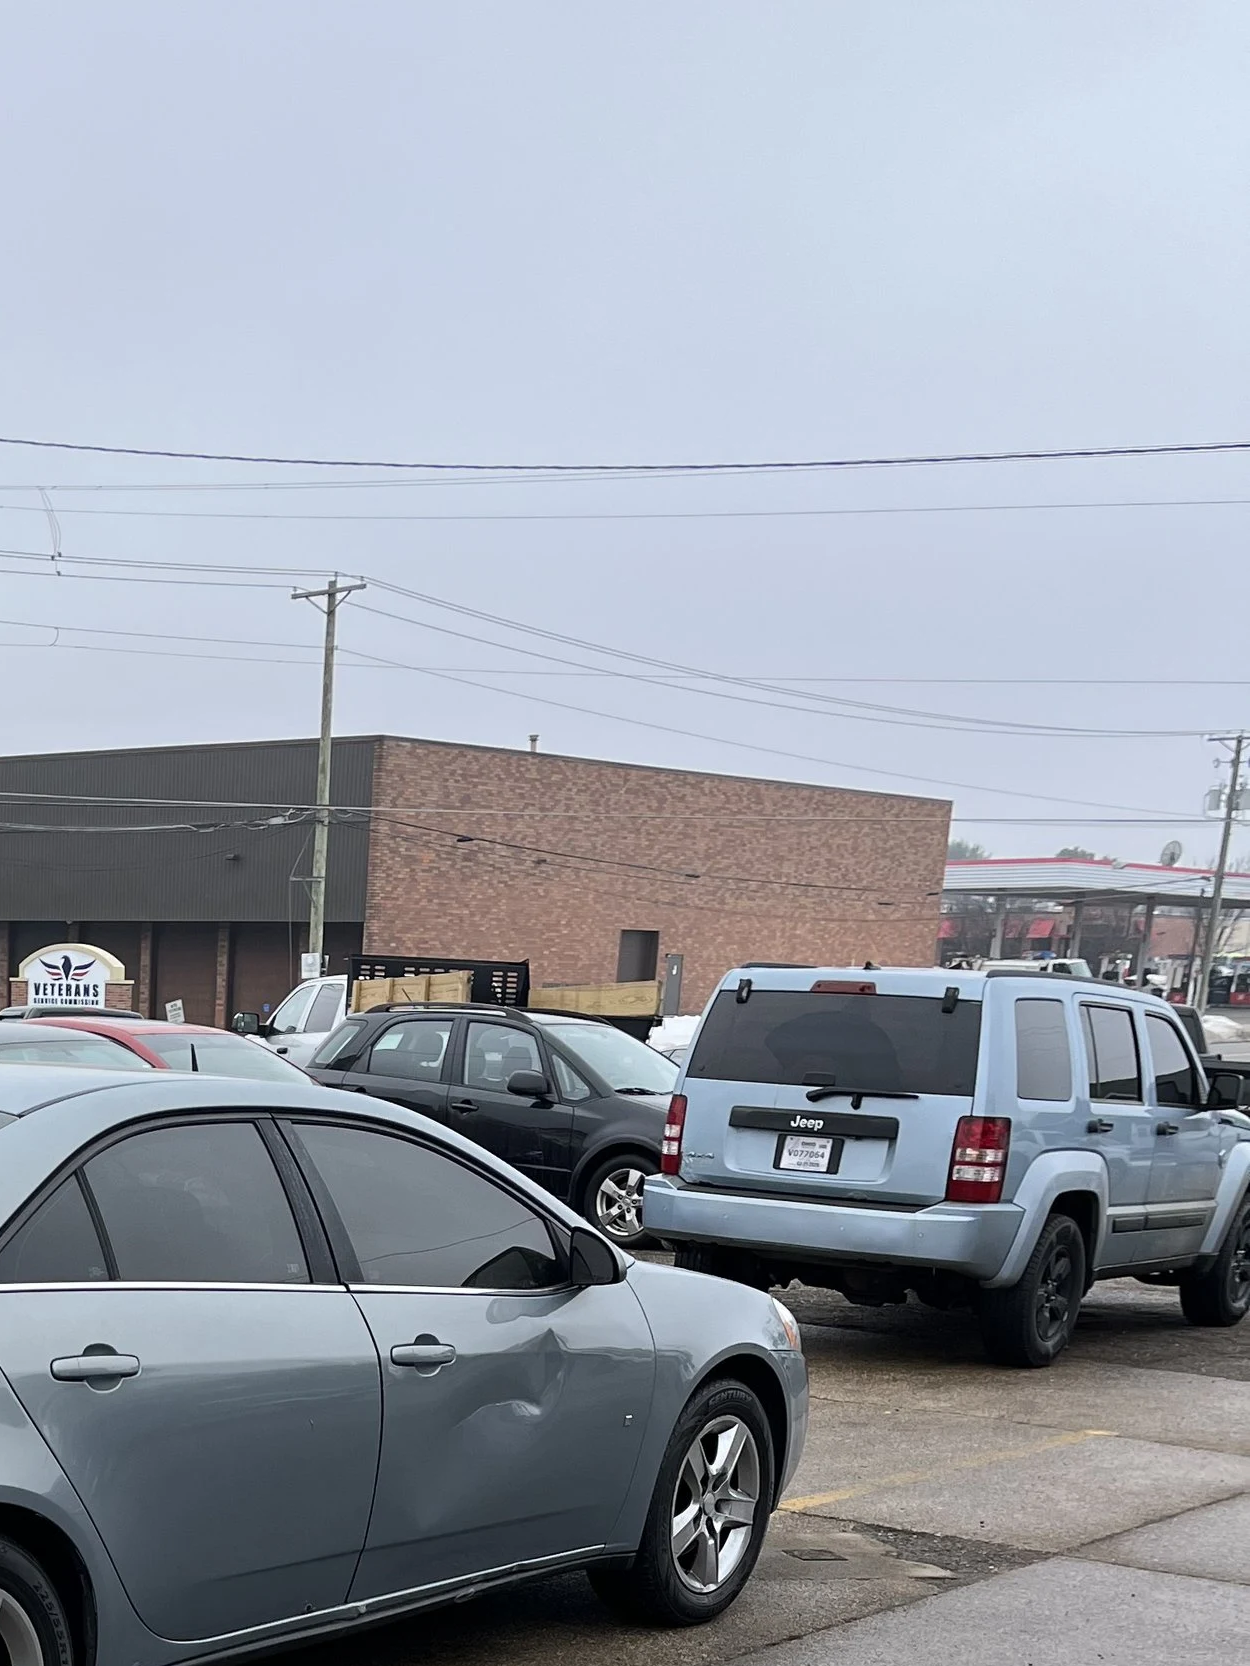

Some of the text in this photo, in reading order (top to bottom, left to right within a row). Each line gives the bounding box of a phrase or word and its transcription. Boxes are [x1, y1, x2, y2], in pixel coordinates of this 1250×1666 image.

[33, 983, 99, 998] VETERANS
[60, 998, 99, 1006] COMMISSION
[790, 1115, 824, 1131] Jeep
[708, 1390, 753, 1407] CENTURY
